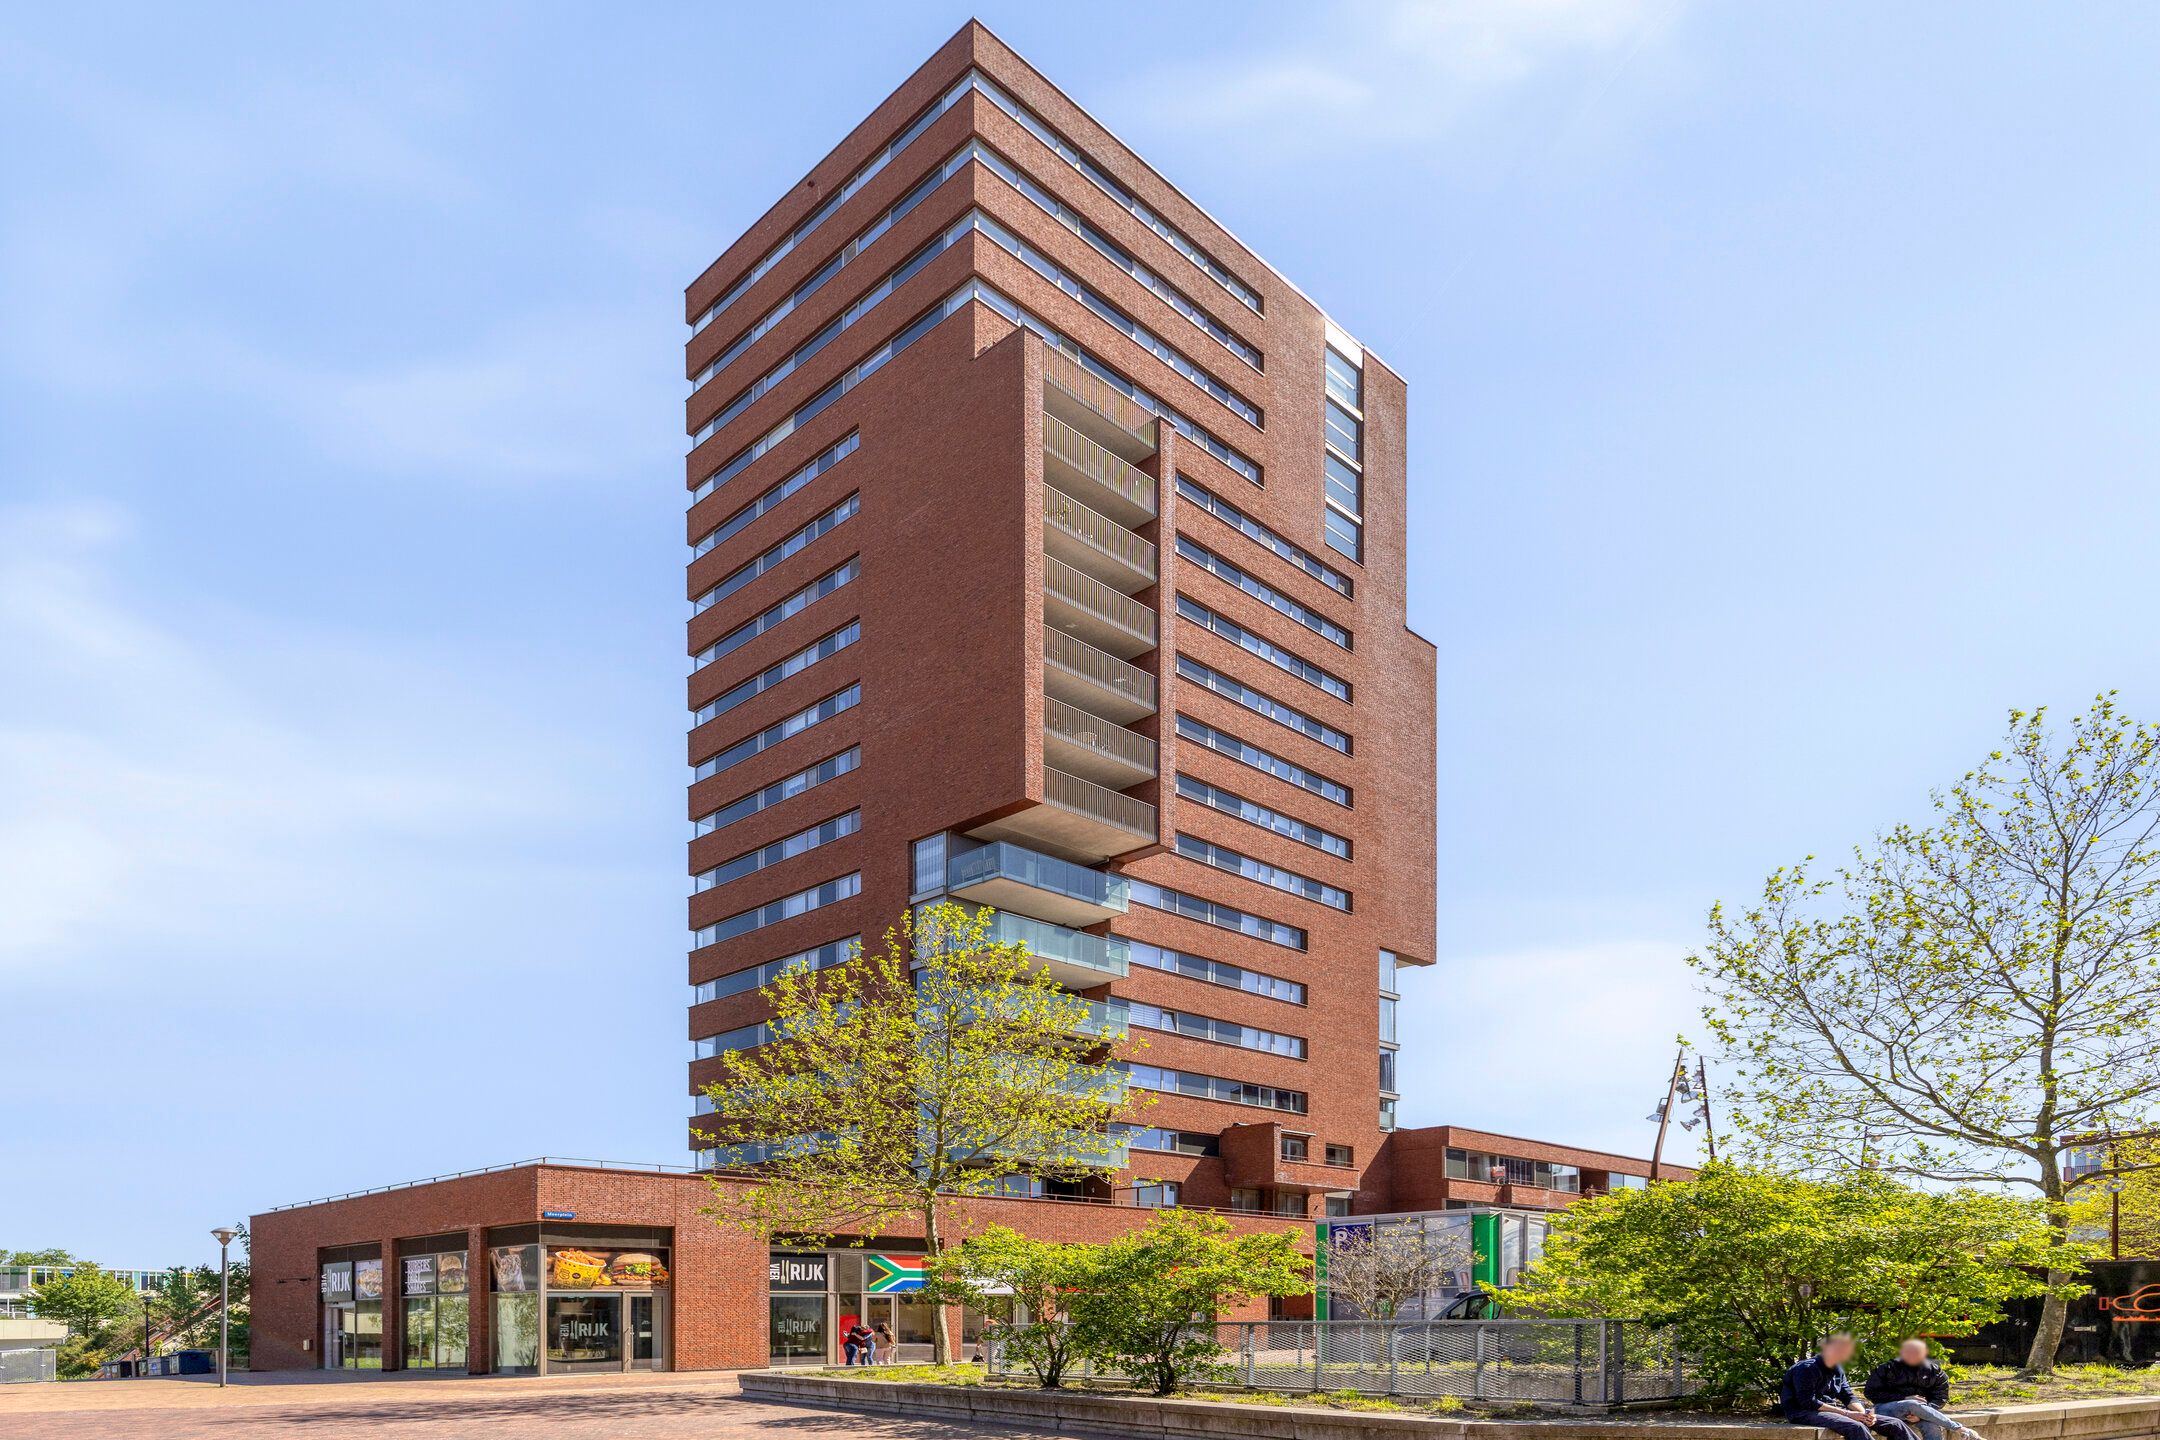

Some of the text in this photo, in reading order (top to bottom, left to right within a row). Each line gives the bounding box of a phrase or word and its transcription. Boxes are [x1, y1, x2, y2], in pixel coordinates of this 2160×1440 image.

[769, 1263, 824, 1281] VIER RIJK
[331, 1271, 351, 1292] RIJK
[560, 1323, 609, 1337] VIER RIJK
[792, 1321, 816, 1333] RIJK
